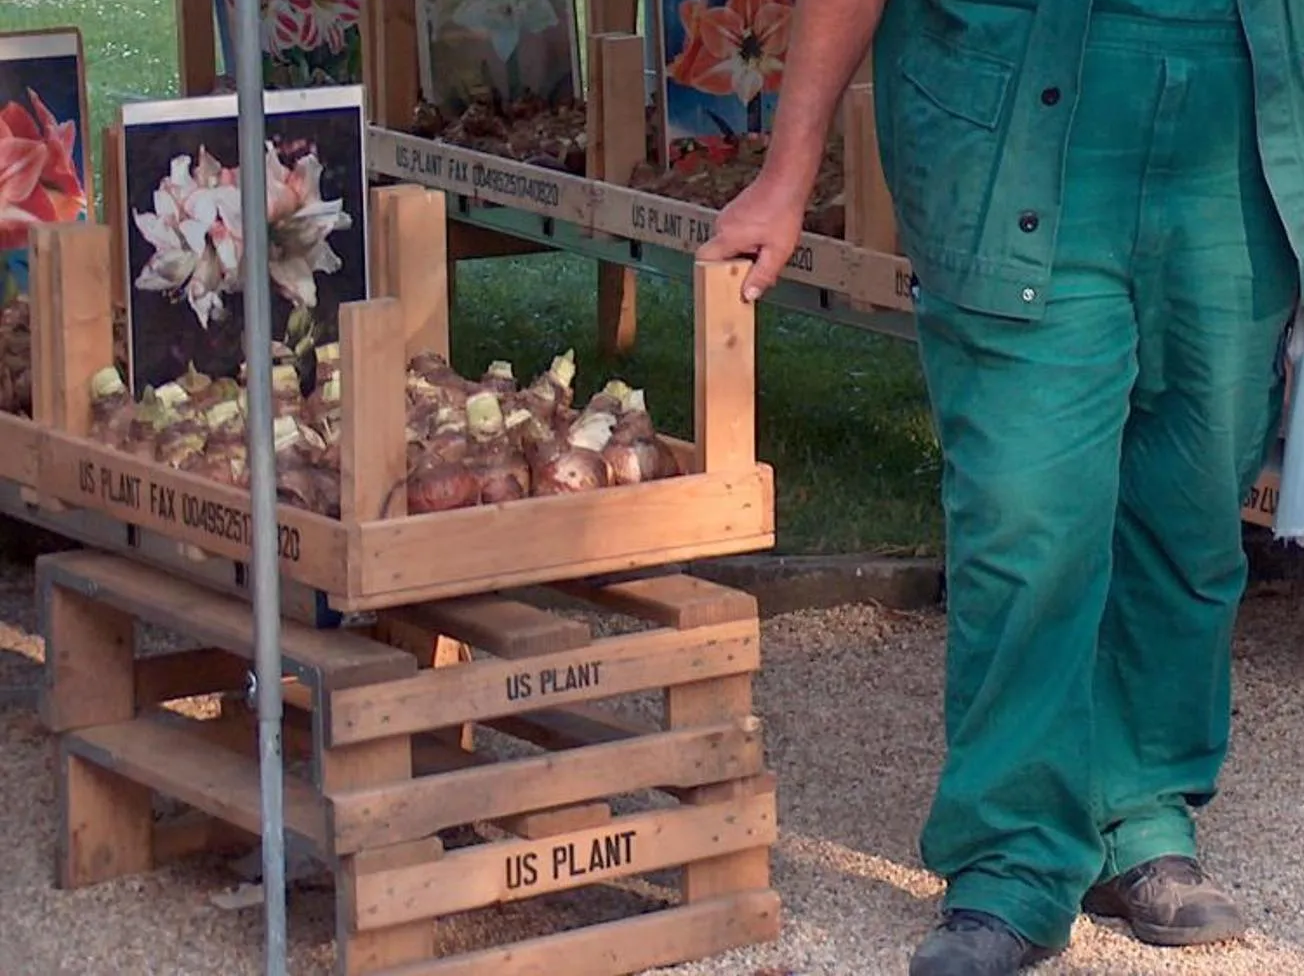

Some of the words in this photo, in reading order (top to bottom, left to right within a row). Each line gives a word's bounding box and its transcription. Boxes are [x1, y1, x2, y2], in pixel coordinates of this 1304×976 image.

[396, 144, 409, 168] US
[412, 147, 443, 176] PLANT
[448, 158, 468, 182] FAX
[632, 203, 645, 229] US
[648, 207, 682, 239] PLANT
[79, 459, 95, 495] US
[101, 467, 141, 511] PLANT
[150, 483, 177, 522] FAX
[506, 672, 532, 701] US
[540, 660, 602, 695] PLANT
[506, 852, 538, 890] US
[552, 830, 637, 880] PLANT
